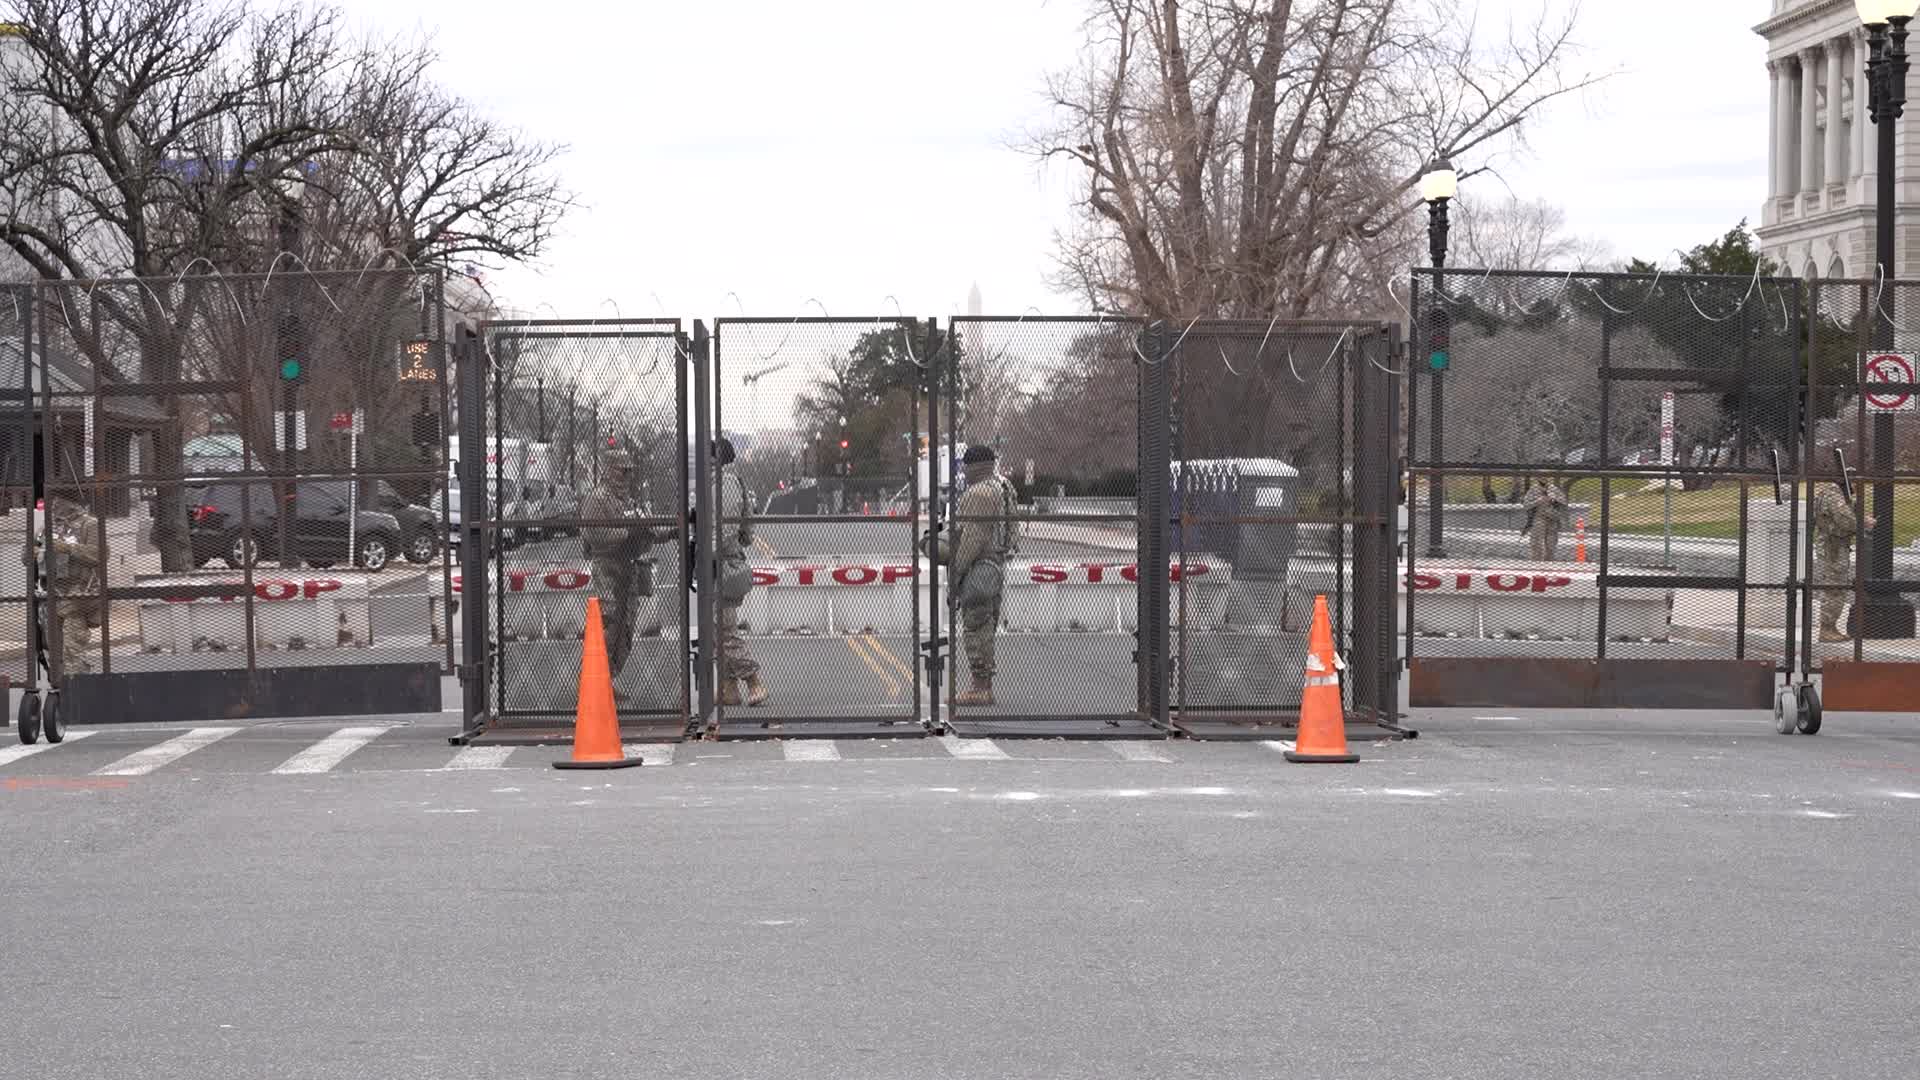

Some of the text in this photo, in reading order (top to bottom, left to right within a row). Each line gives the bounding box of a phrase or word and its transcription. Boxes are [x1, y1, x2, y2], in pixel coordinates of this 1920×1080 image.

[406, 343, 429, 354] USE
[413, 354, 423, 368] 2
[1403, 573, 1571, 592] STOP
